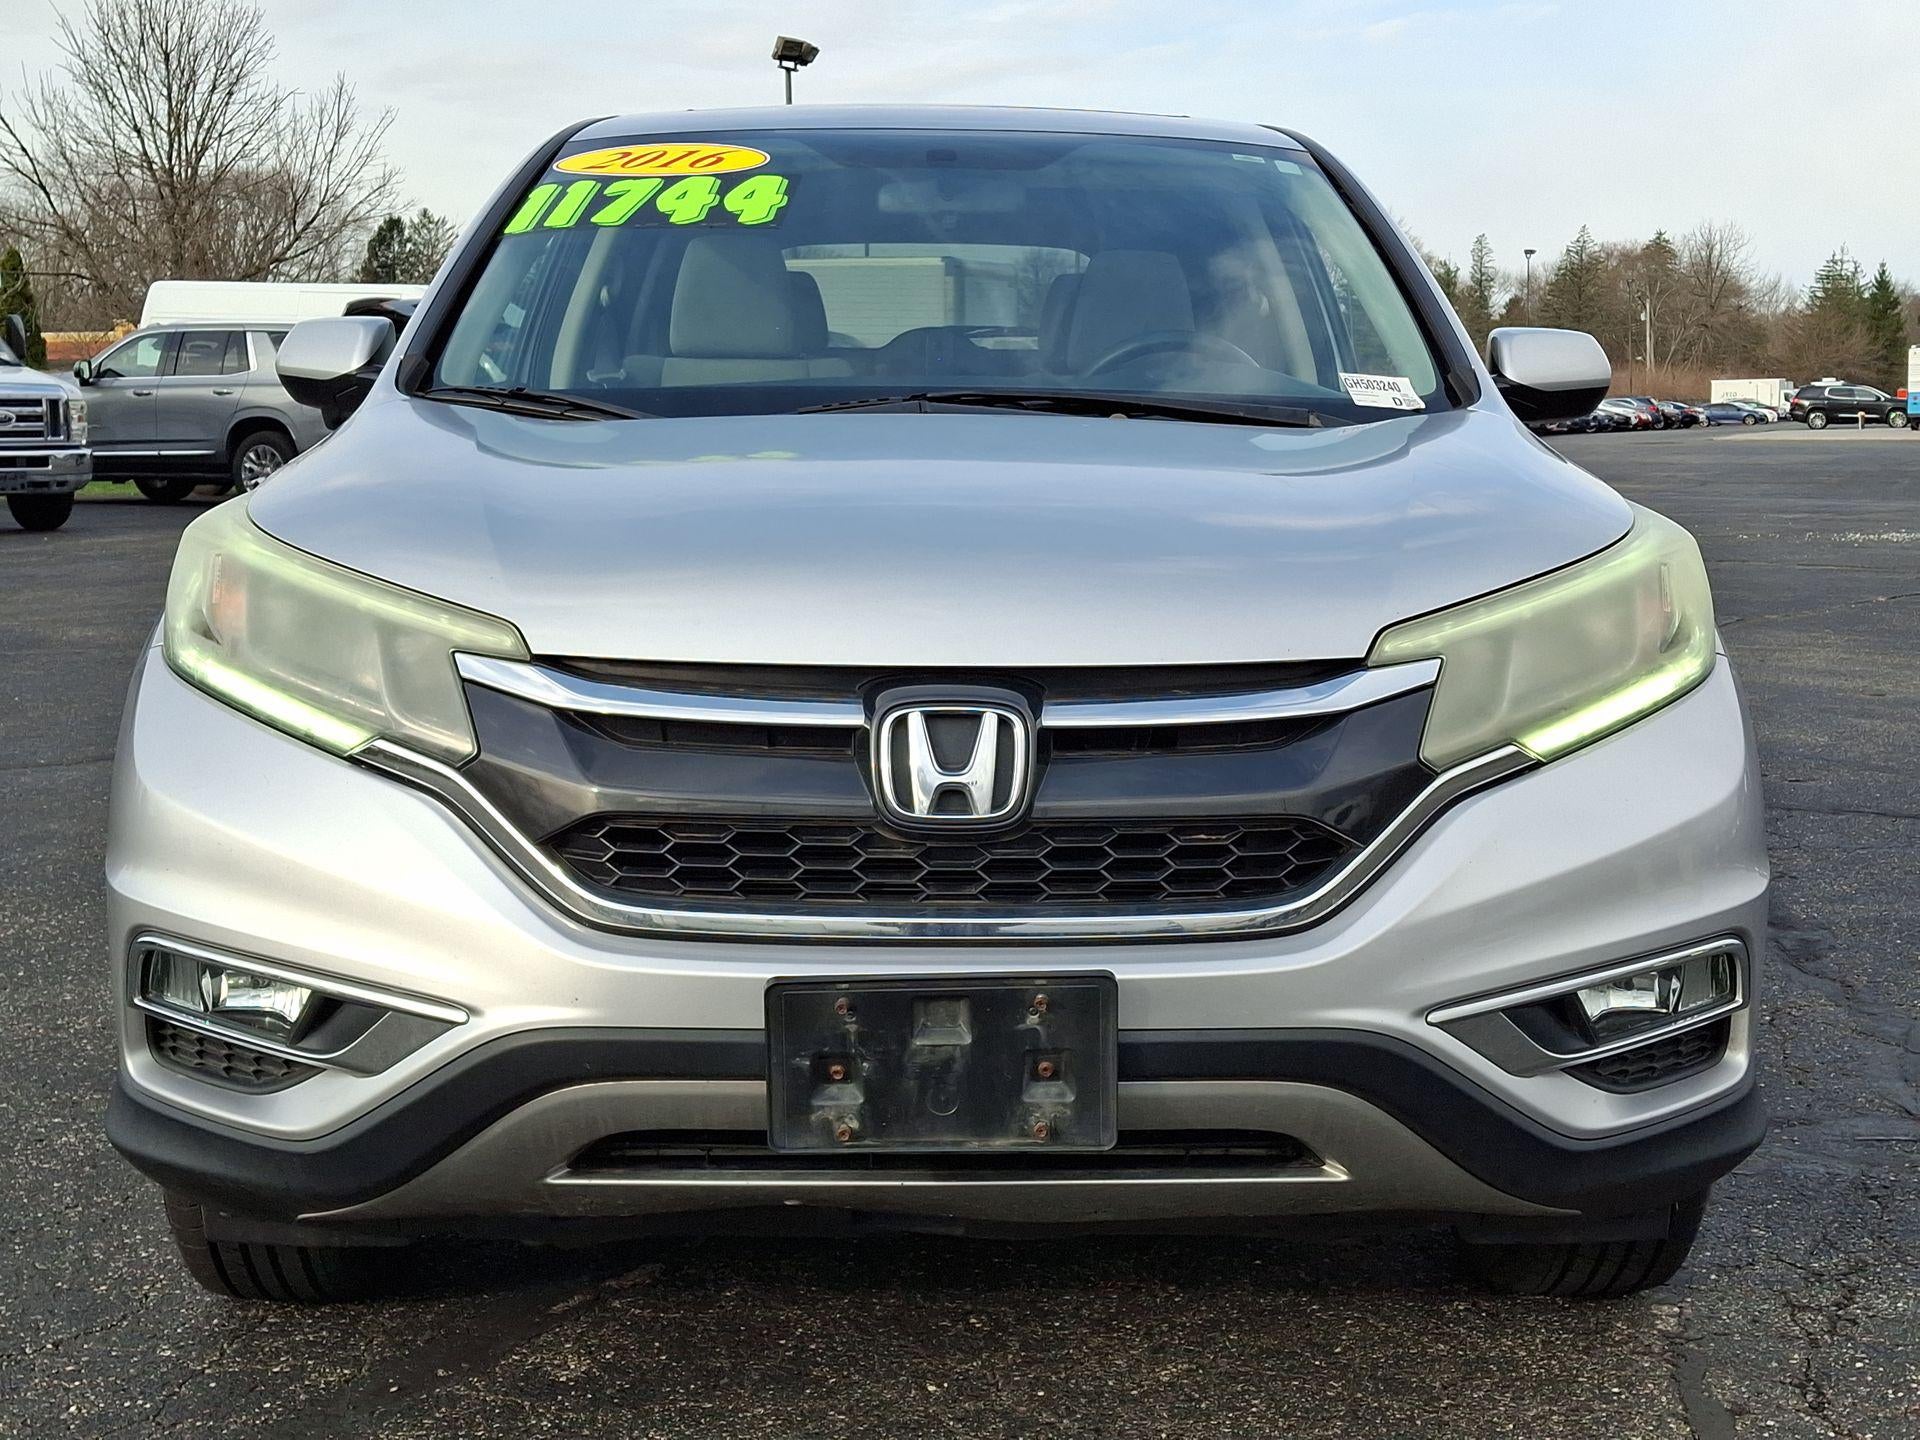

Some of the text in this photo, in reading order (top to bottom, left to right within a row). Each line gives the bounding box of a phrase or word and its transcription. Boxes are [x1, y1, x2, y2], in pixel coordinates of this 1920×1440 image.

[581, 149, 738, 169] 2016
[503, 174, 789, 234] 11744
[1344, 377, 1401, 393] GH503240
[1392, 397, 1403, 407] D
